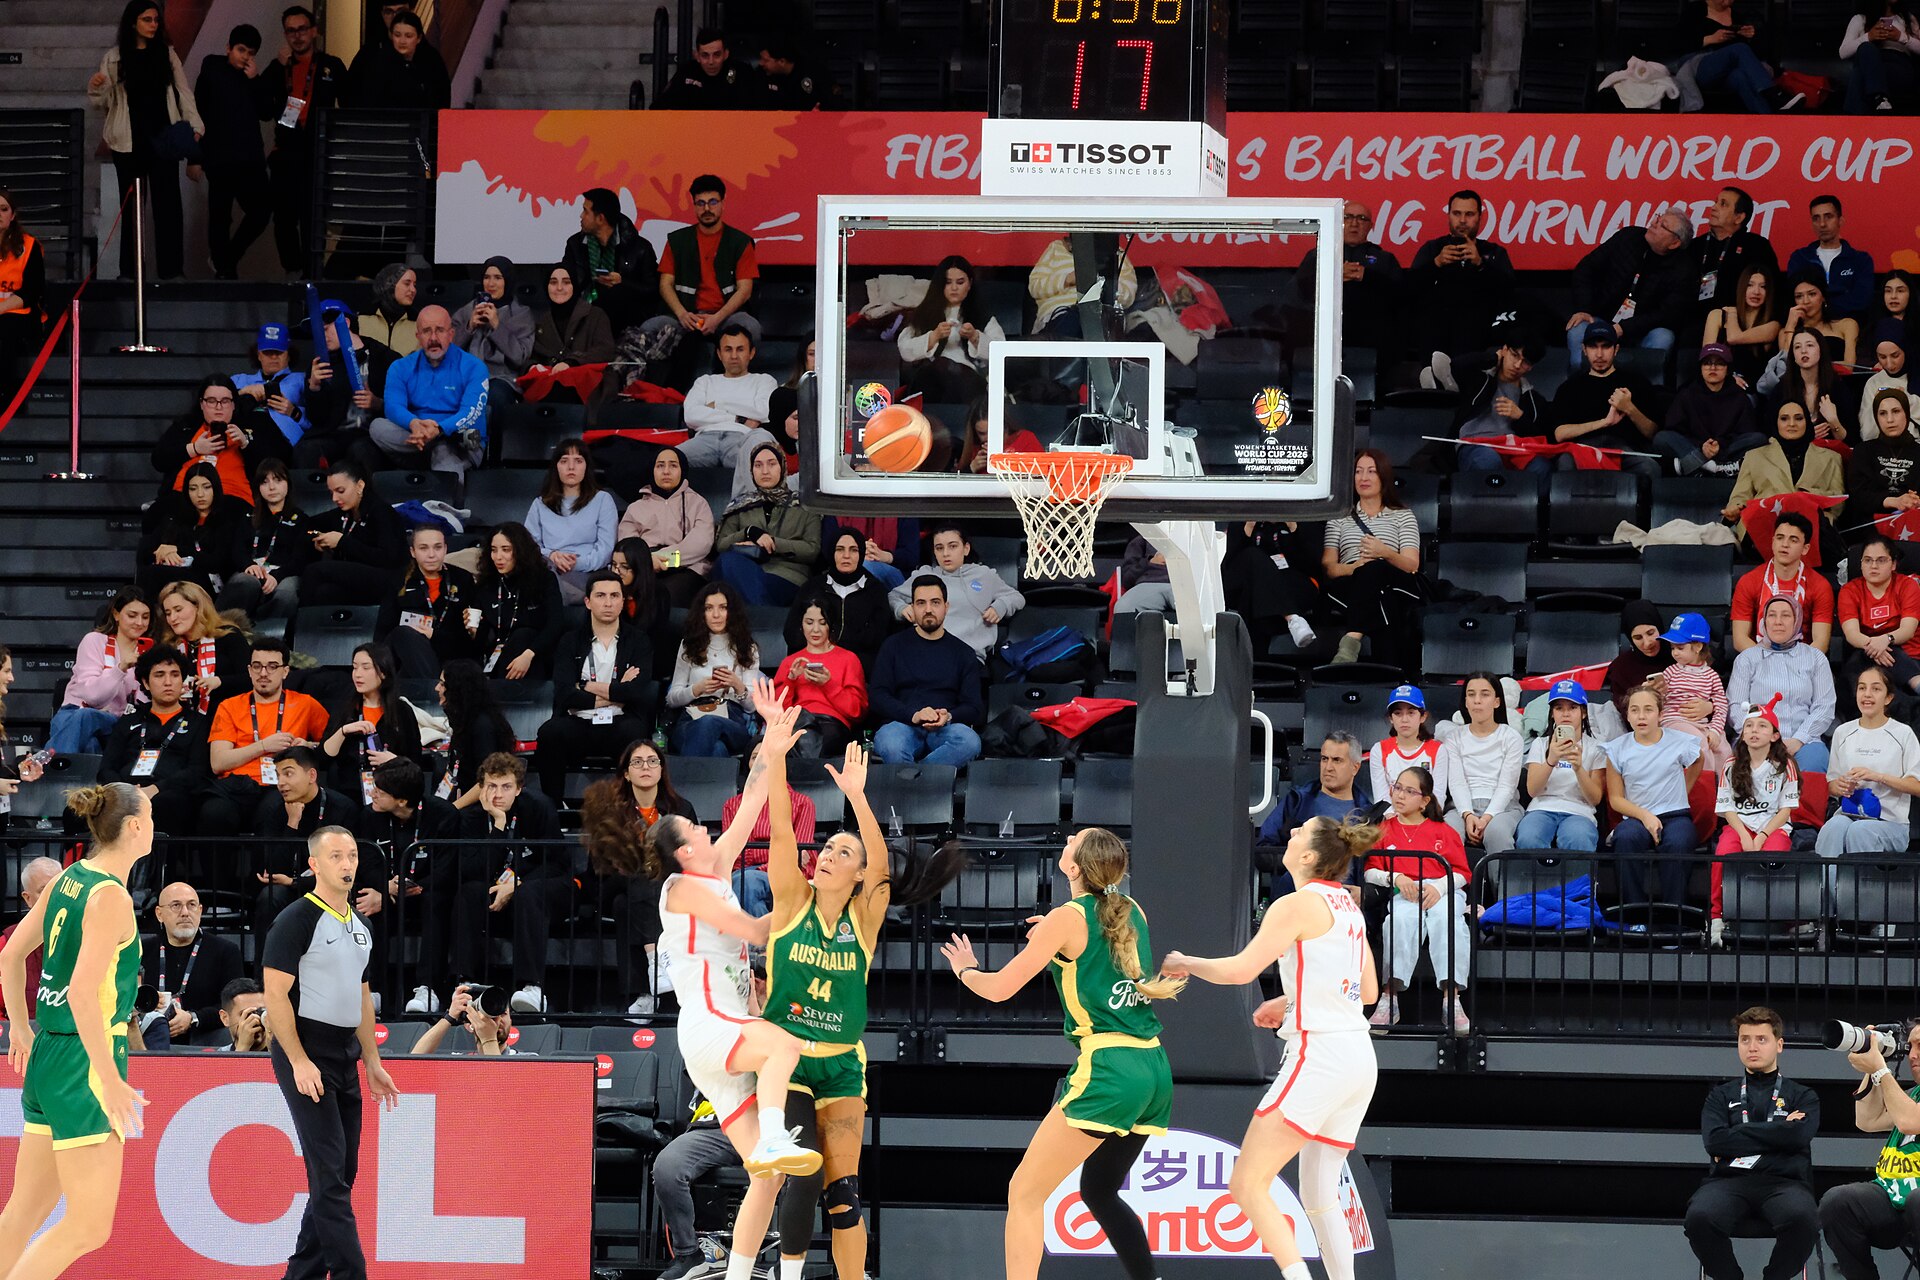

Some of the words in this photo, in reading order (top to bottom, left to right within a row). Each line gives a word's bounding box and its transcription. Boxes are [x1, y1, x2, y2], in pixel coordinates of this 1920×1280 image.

[1072, 40, 1154, 110] 17
[1057, 143, 1172, 165] TISSOT
[1285, 134, 1586, 181] BASKETBALL
[1606, 134, 1781, 181] WORLD
[1801, 136, 1914, 184] CUP
[1010, 166, 1044, 174] SWISS
[25, 455, 34, 463] 10
[1234, 450, 1266, 458] WORLD
[1267, 450, 1285, 458] CUP
[1286, 451, 1308, 459] 2026
[64, 660, 75, 669] 07
[22, 734, 34, 743] 06
[60, 875, 84, 900] TALBOT
[48, 907, 68, 959] 6
[788, 942, 857, 971] AUSTRALIA
[806, 977, 833, 1003] 44
[786, 1013, 842, 1033] CONSULTING
[803, 1006, 843, 1023] SEVEN
[1119, 1149, 1238, 1192] 岁山
